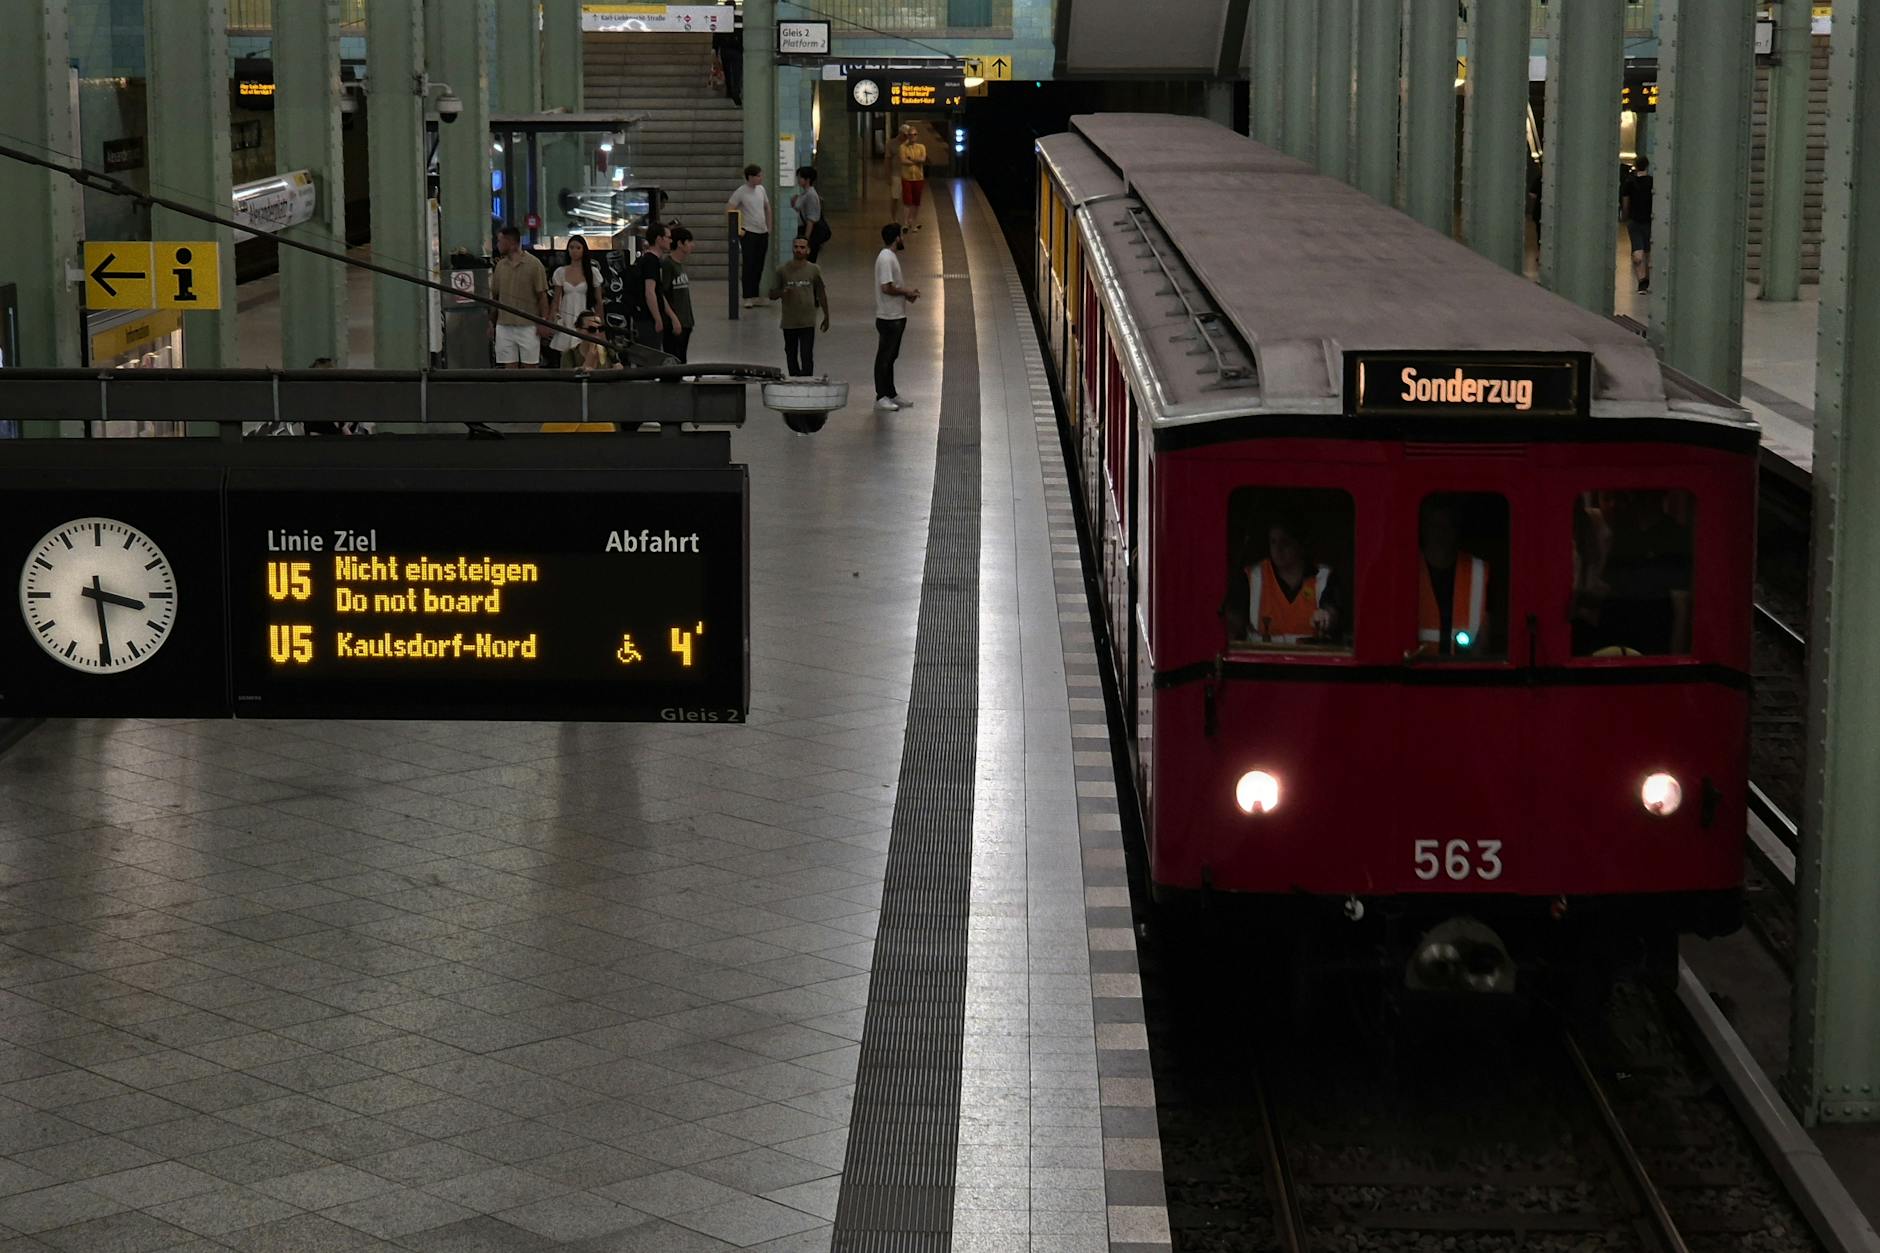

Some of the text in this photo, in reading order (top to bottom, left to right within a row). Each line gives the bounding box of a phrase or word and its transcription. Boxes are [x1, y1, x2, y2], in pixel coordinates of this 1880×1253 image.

[782, 28, 810, 38] Gleis 2
[782, 39, 826, 49] Platform 2
[1401, 367, 1533, 410] Sonderzug
[267, 529, 700, 553] Linie Ziel Abfahrt
[267, 556, 538, 600] U5 Nicht einsteigen
[336, 587, 500, 613] Do not board
[269, 624, 313, 663] U5
[337, 632, 537, 659] Kaulsdorf-Nord
[660, 708, 739, 722] Gleis 2
[1415, 840, 1501, 879] 563
